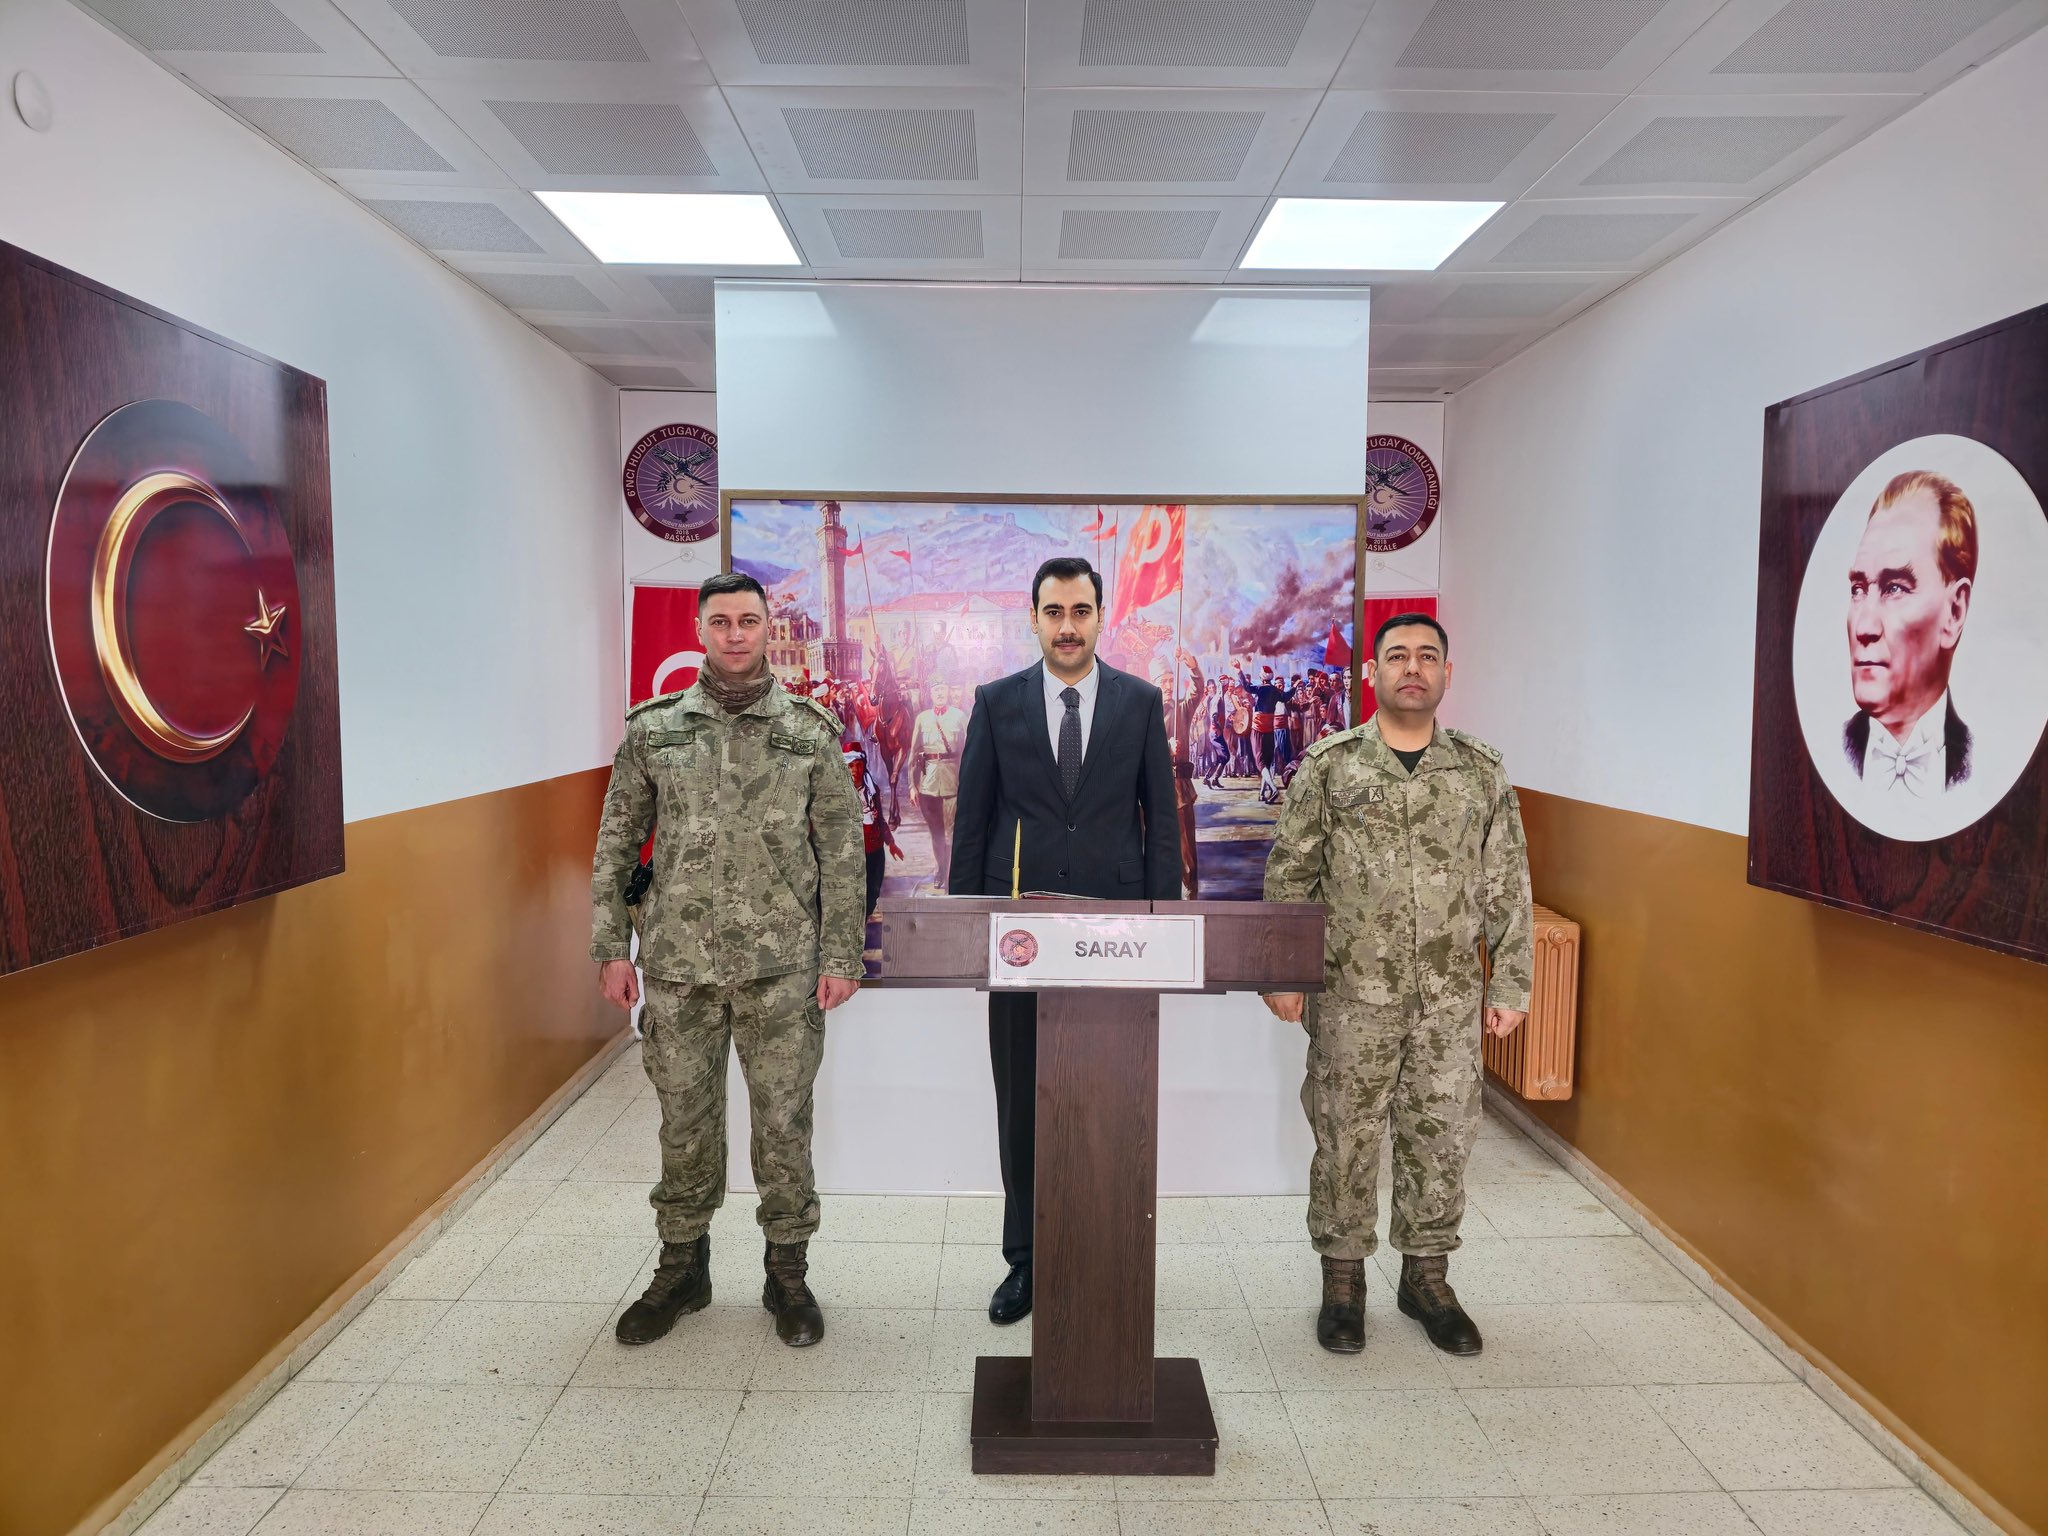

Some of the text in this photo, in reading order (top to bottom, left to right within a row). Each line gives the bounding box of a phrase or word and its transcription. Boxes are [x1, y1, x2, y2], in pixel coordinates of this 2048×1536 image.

[629, 433, 658, 467] HUDUT
[660, 426, 699, 438] TUGAY
[1402, 443, 1439, 510] KOMUTANLIĞI
[1074, 940, 1148, 958] SARAY
